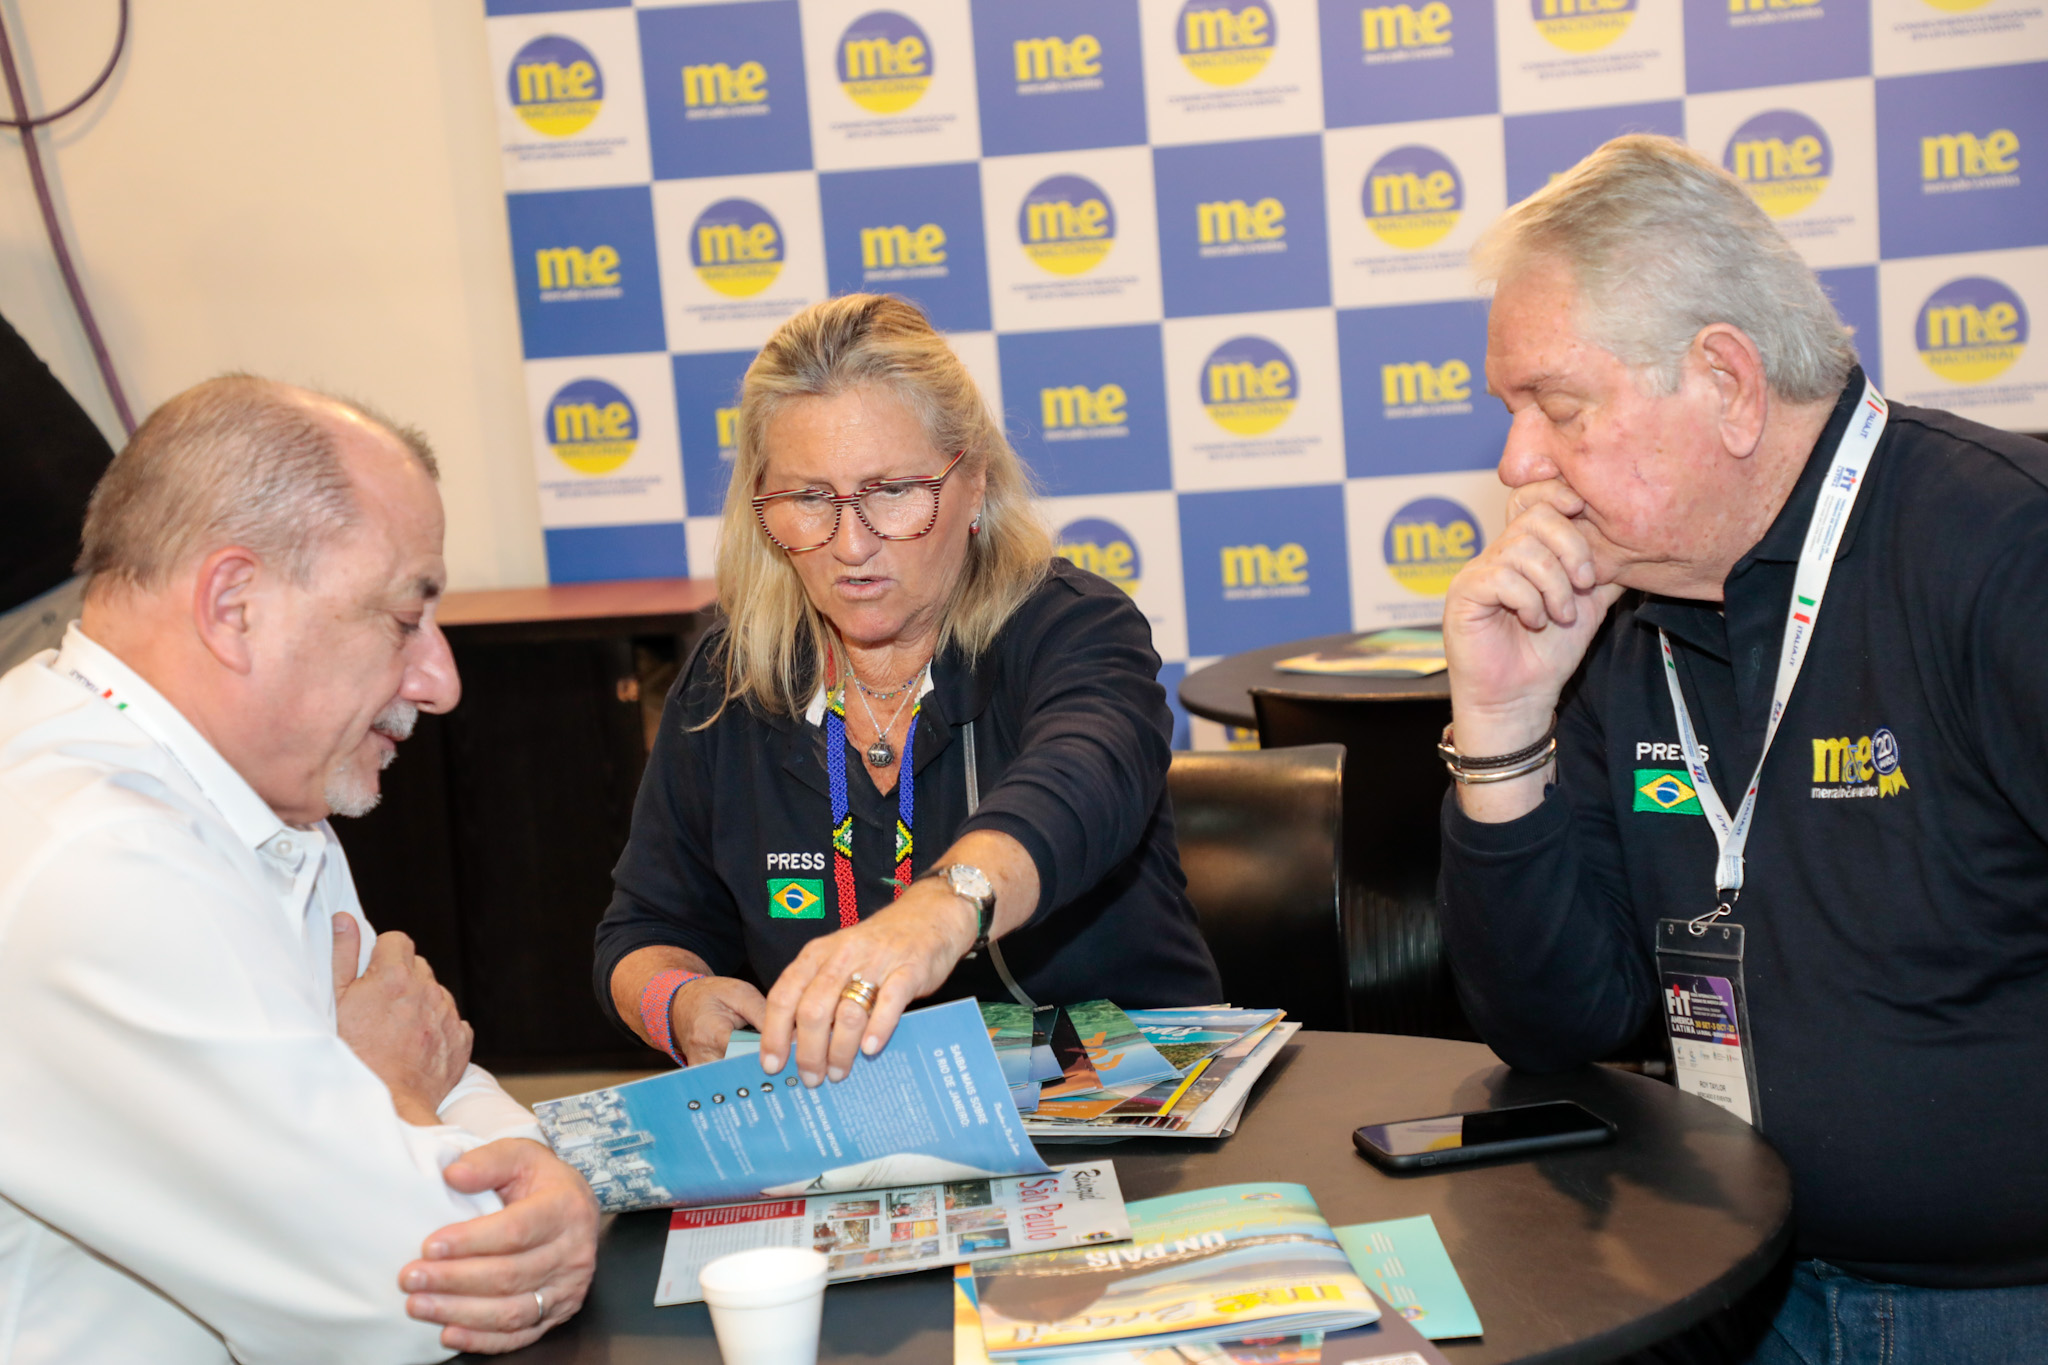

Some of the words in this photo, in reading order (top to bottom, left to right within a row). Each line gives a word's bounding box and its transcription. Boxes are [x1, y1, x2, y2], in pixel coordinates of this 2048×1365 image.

[1636, 742, 1710, 762] PRES
[1875, 733, 1893, 759] 20
[1812, 735, 1876, 784] m&e
[766, 852, 826, 871] PRESS
[1671, 1024, 1696, 1034] LATINA
[932, 1047, 944, 1058] O
[936, 1056, 950, 1075] RIO
[943, 1074, 956, 1089] DE
[949, 1043, 967, 1072] SAIBA
[960, 1072, 976, 1096] MAIS
[968, 1094, 988, 1126] SOBRE
[1709, 1082, 1726, 1091] TAYLOR
[948, 1088, 970, 1128] JANEIRO:
[814, 1104, 831, 1132] SOCIAIS
[825, 1131, 842, 1158] OFICIAIS
[1019, 1178, 1059, 1202] São
[1024, 1203, 1068, 1240] Paulo
[1175, 1231, 1227, 1249] UN
